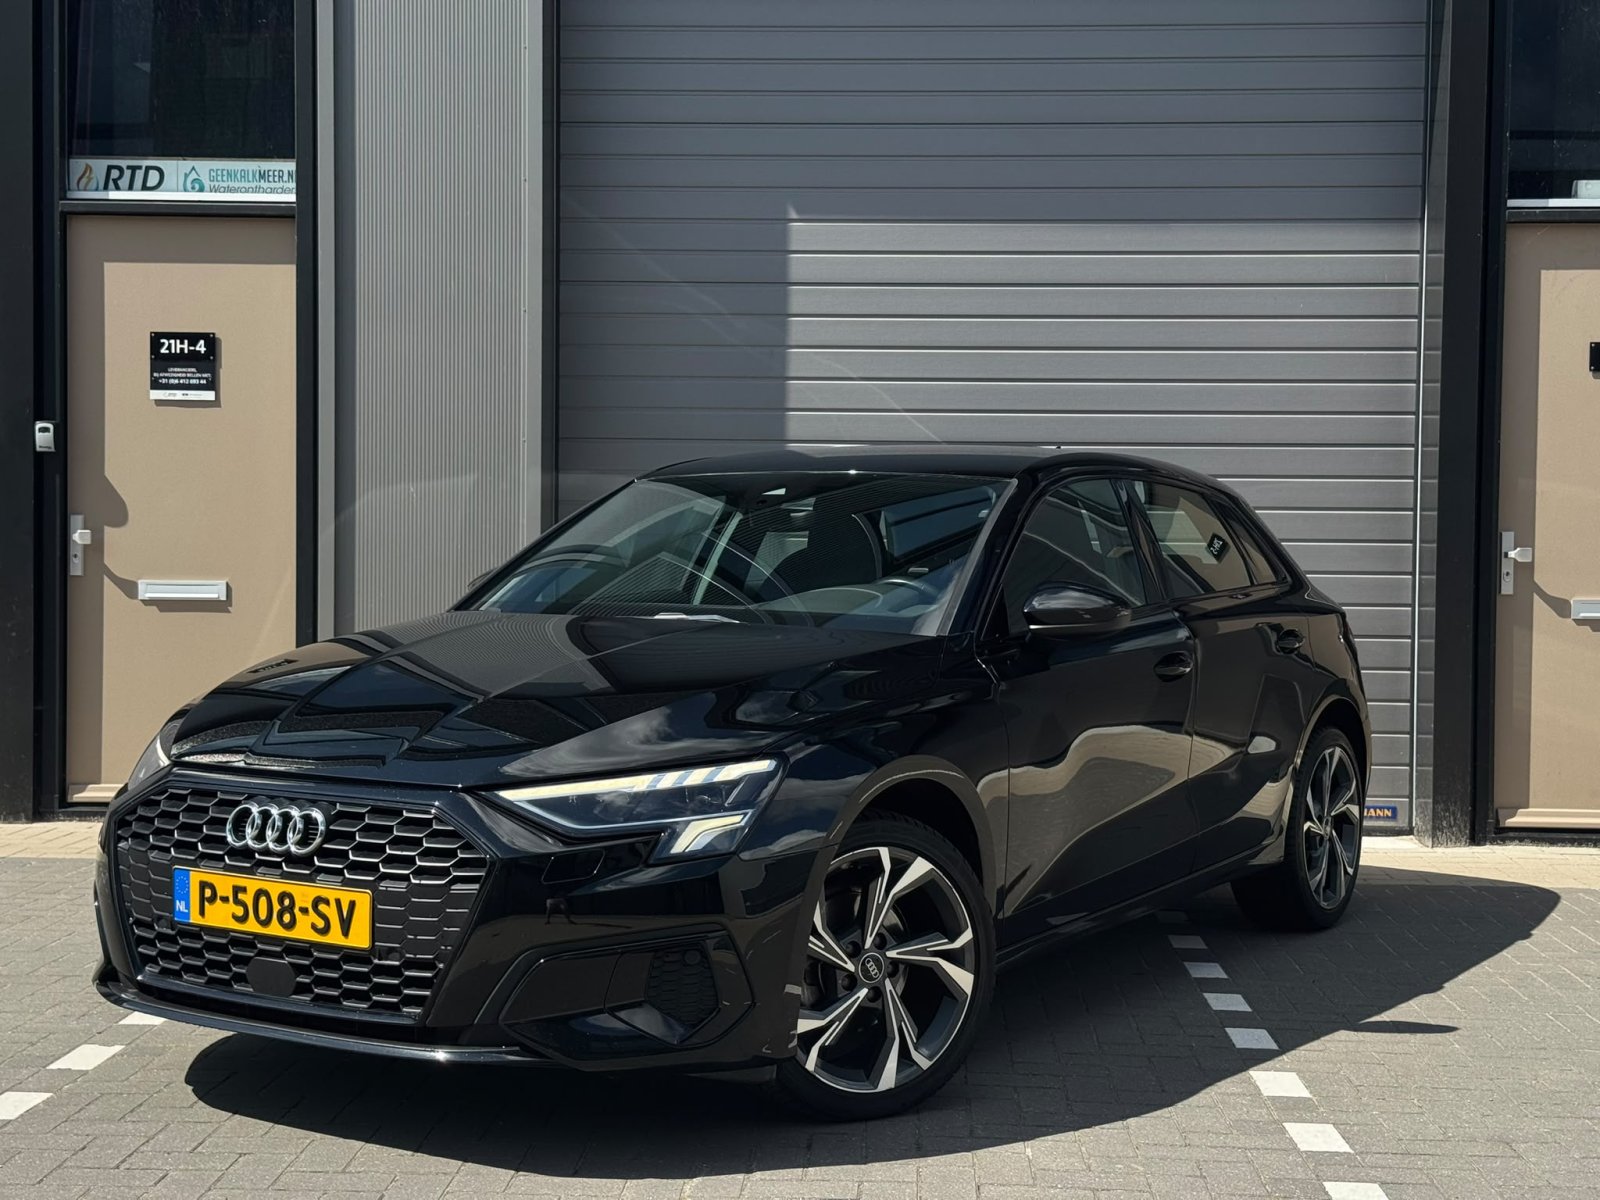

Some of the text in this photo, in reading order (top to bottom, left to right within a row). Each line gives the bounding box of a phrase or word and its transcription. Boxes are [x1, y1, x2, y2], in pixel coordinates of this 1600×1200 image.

[103, 164, 165, 192] RTD
[209, 183, 296, 194] Waterontharder
[159, 338, 207, 355] 21H-4
[175, 899, 188, 913] NL
[198, 879, 357, 939] P-508-SV
